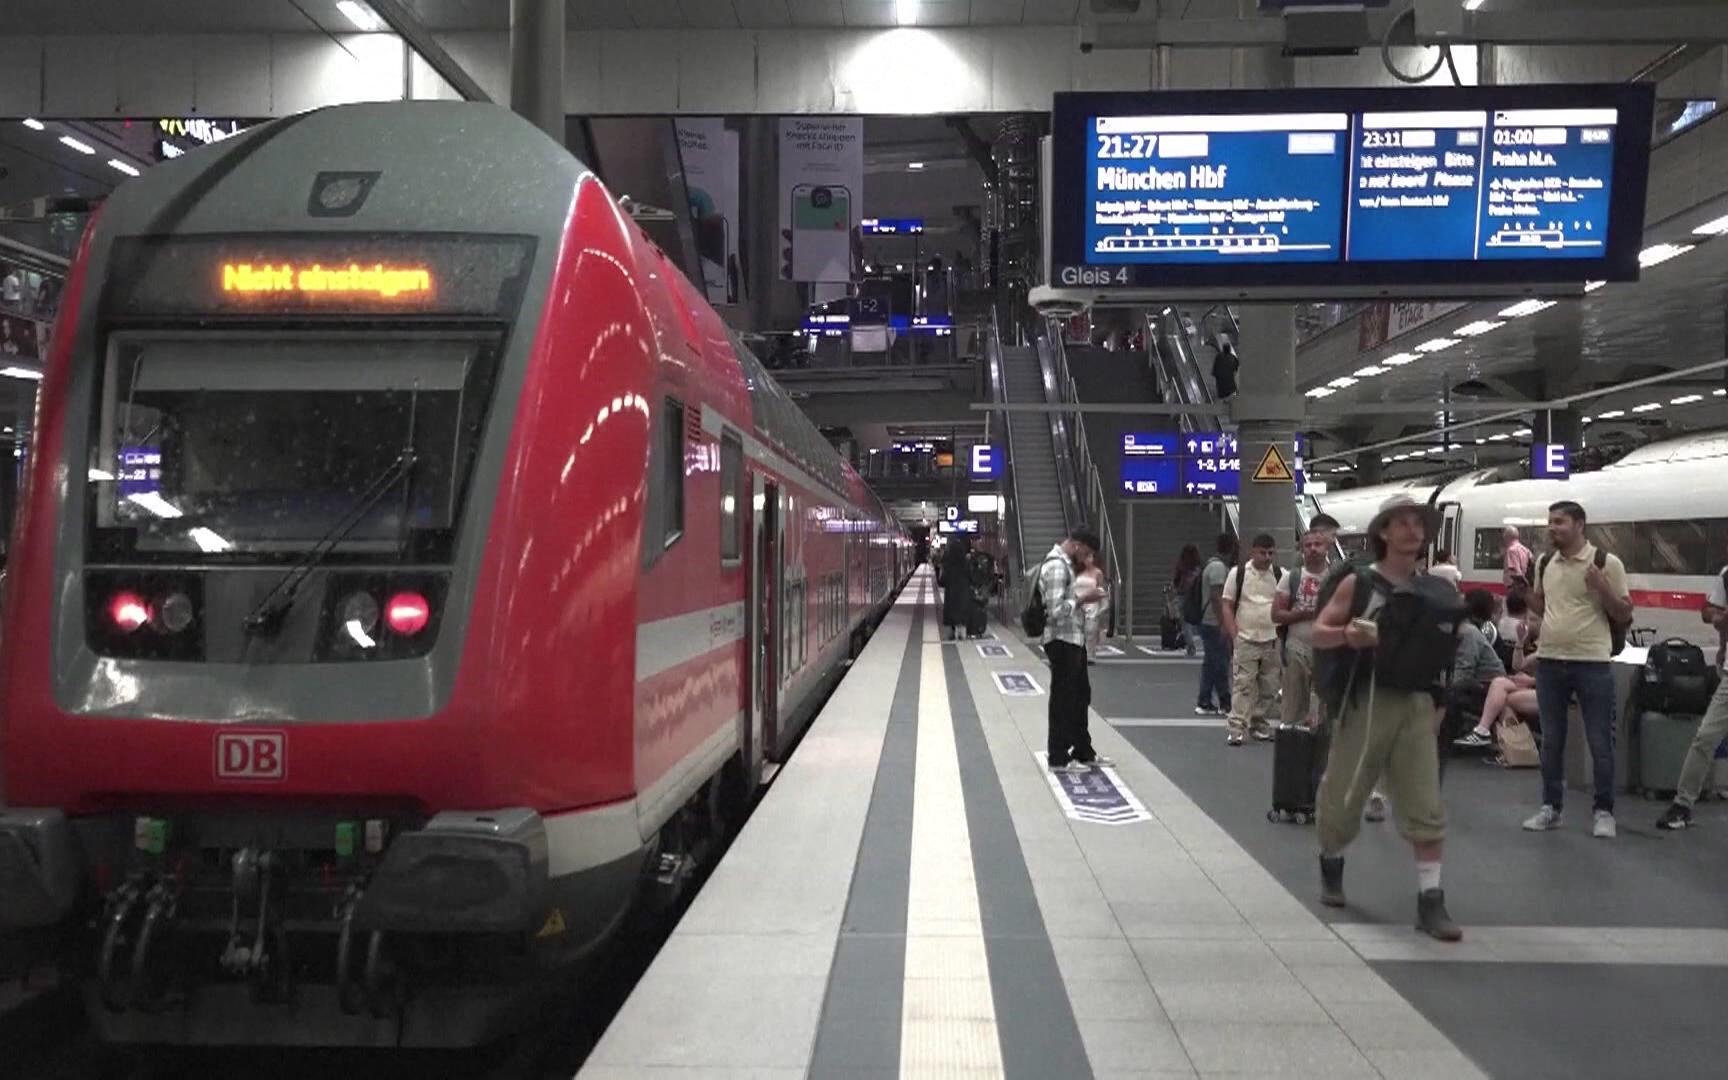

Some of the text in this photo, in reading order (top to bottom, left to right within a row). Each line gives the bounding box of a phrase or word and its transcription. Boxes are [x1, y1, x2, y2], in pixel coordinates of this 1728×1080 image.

[1097, 134, 1158, 159] 21:27
[1362, 131, 1402, 148] 23:11
[1493, 128, 1534, 146] 01:00
[1492, 150, 1528, 167] Praha
[1097, 164, 1228, 191] München Hbf
[224, 264, 429, 297] Nicht einsteigen
[1061, 266, 1129, 285] Gleis 4
[972, 444, 993, 473] E
[1545, 444, 1566, 473] E
[222, 738, 279, 773] DB
